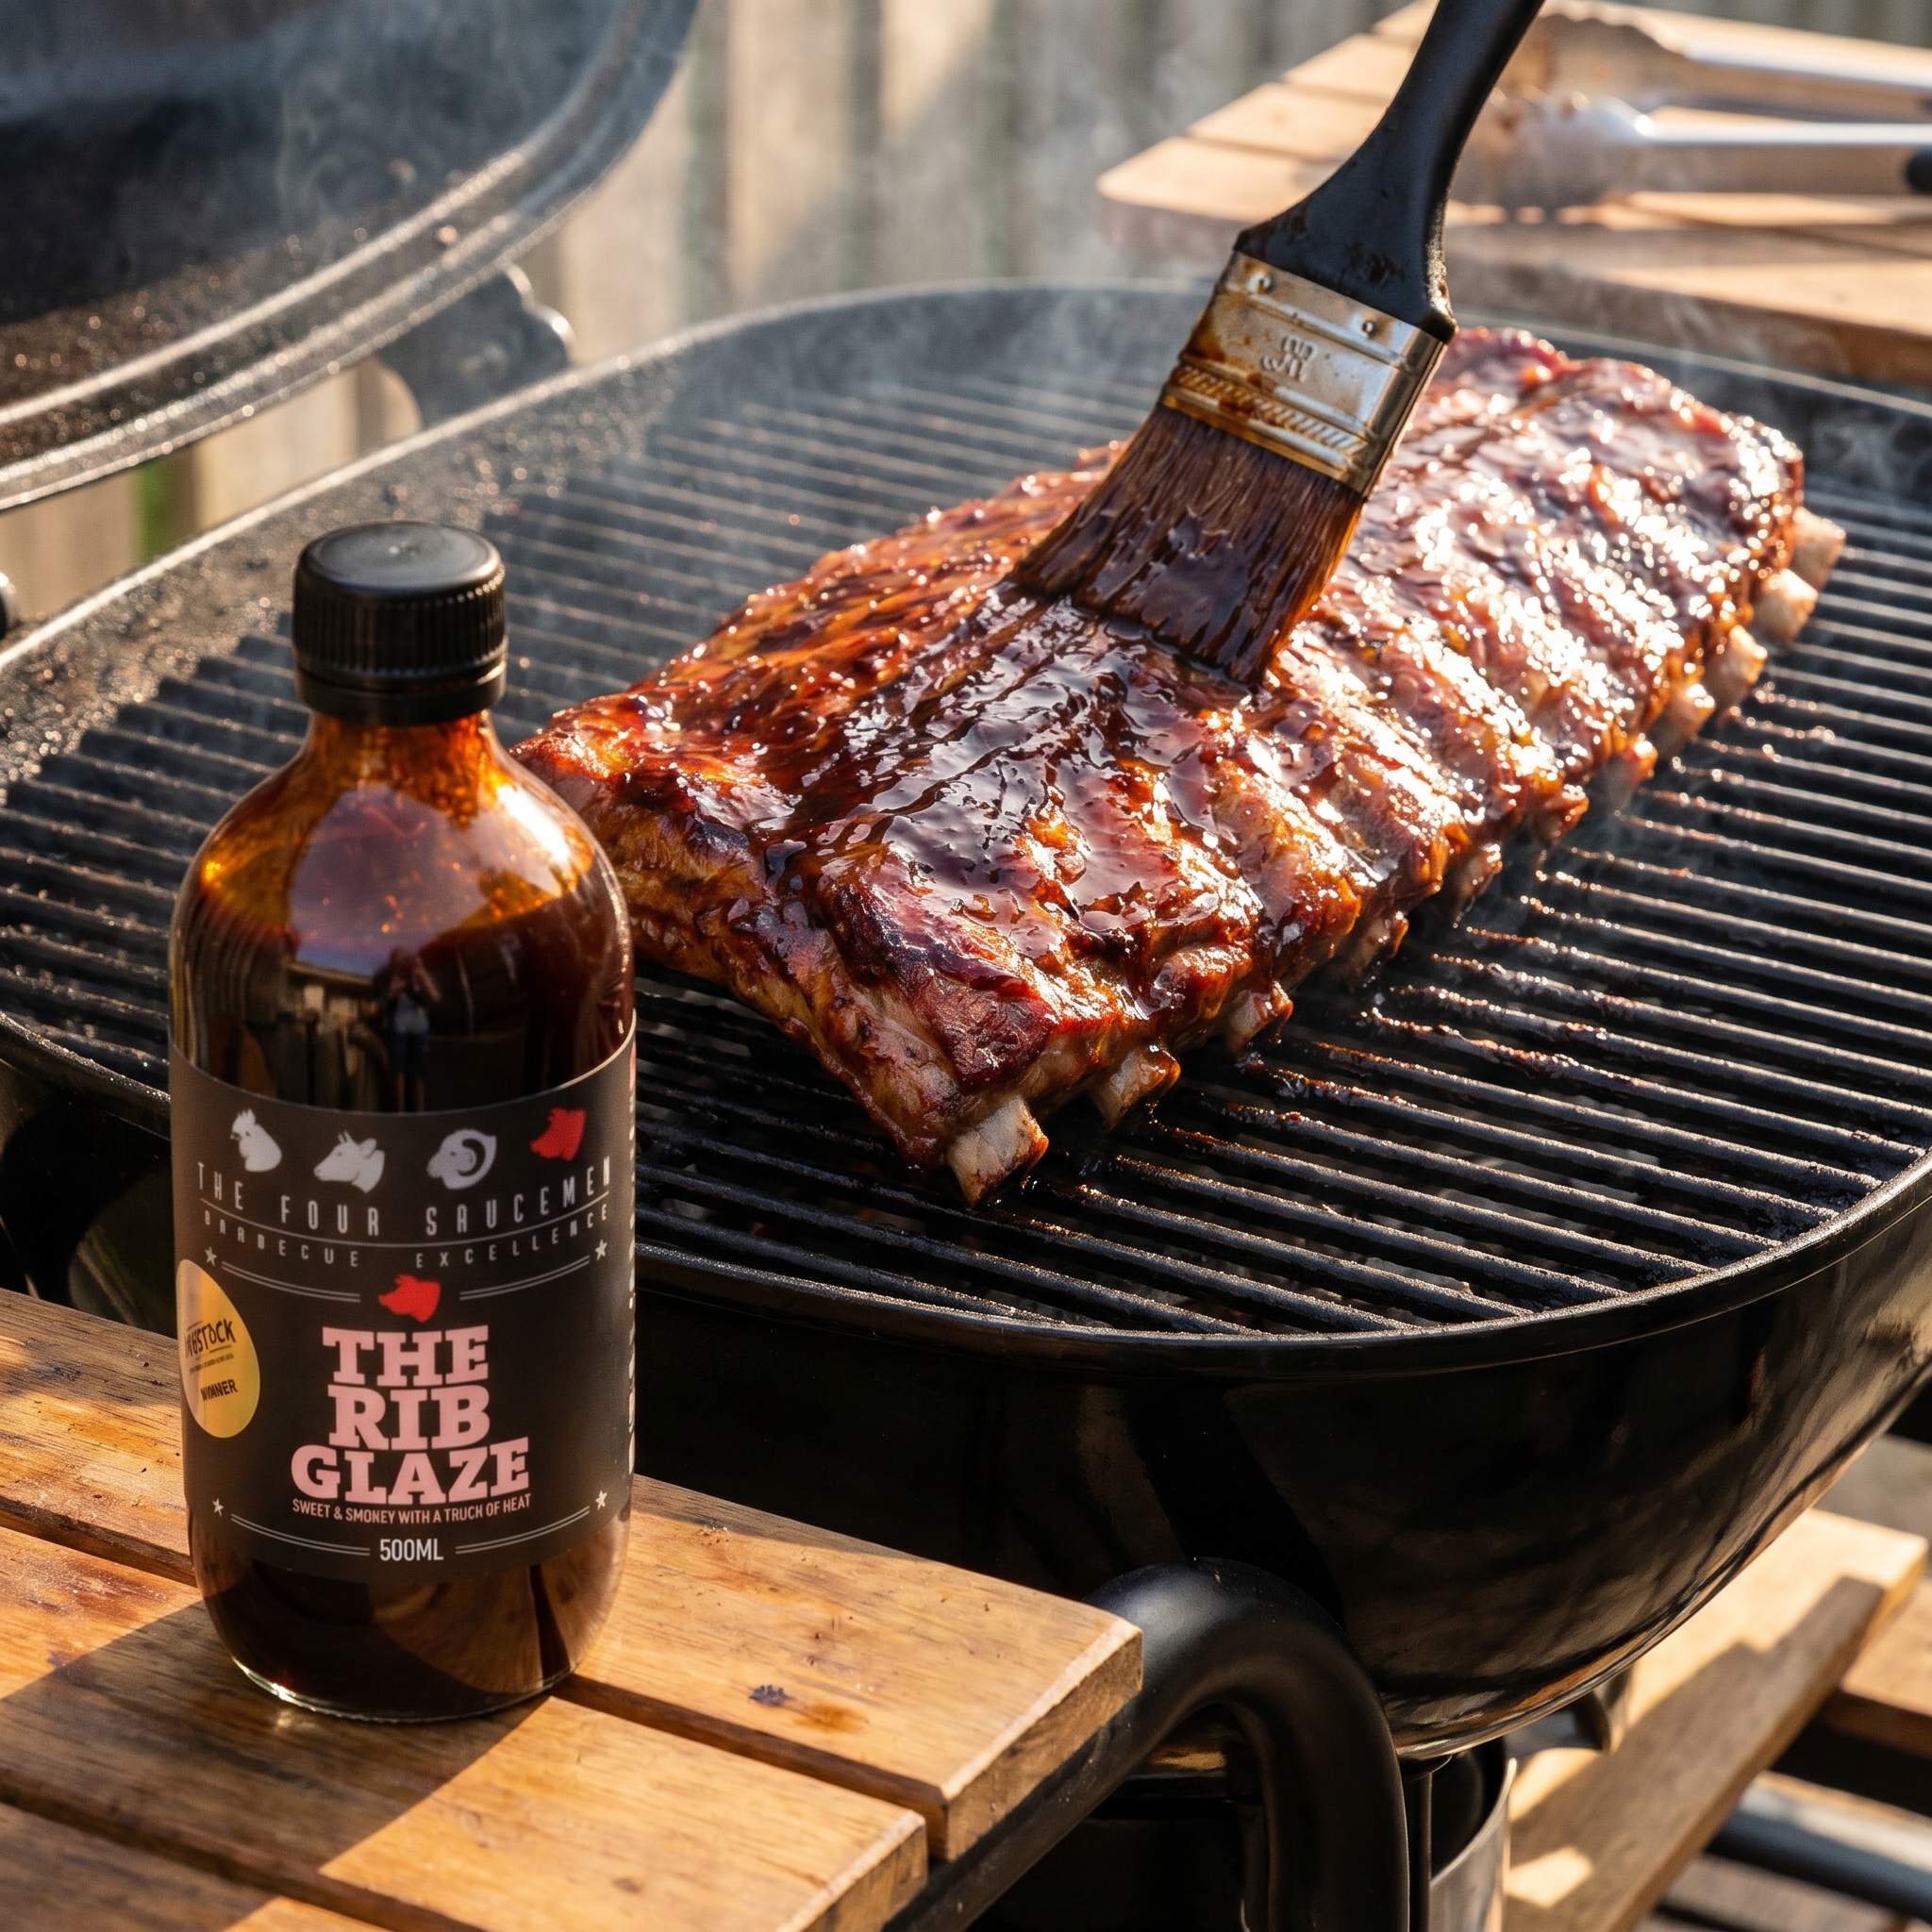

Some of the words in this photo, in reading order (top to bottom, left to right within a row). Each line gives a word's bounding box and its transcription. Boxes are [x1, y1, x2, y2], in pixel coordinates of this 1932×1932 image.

[198, 1161, 243, 1210] THE
[281, 1195, 379, 1237] FOUR
[425, 1156, 610, 1236] SAUCEMEN
[416, 1204, 608, 1269] EXCELLENCE
[322, 1324, 490, 1387] THE
[327, 1384, 491, 1452] RIB
[291, 1437, 530, 1506] GLAZE
[292, 1498, 331, 1519] SWEET
[333, 1506, 343, 1521] &
[398, 1509, 430, 1524] WITH
[432, 1509, 442, 1524] A
[486, 1500, 501, 1517] OF
[503, 1492, 532, 1514] HEAT
[379, 1538, 444, 1562] 500ML
